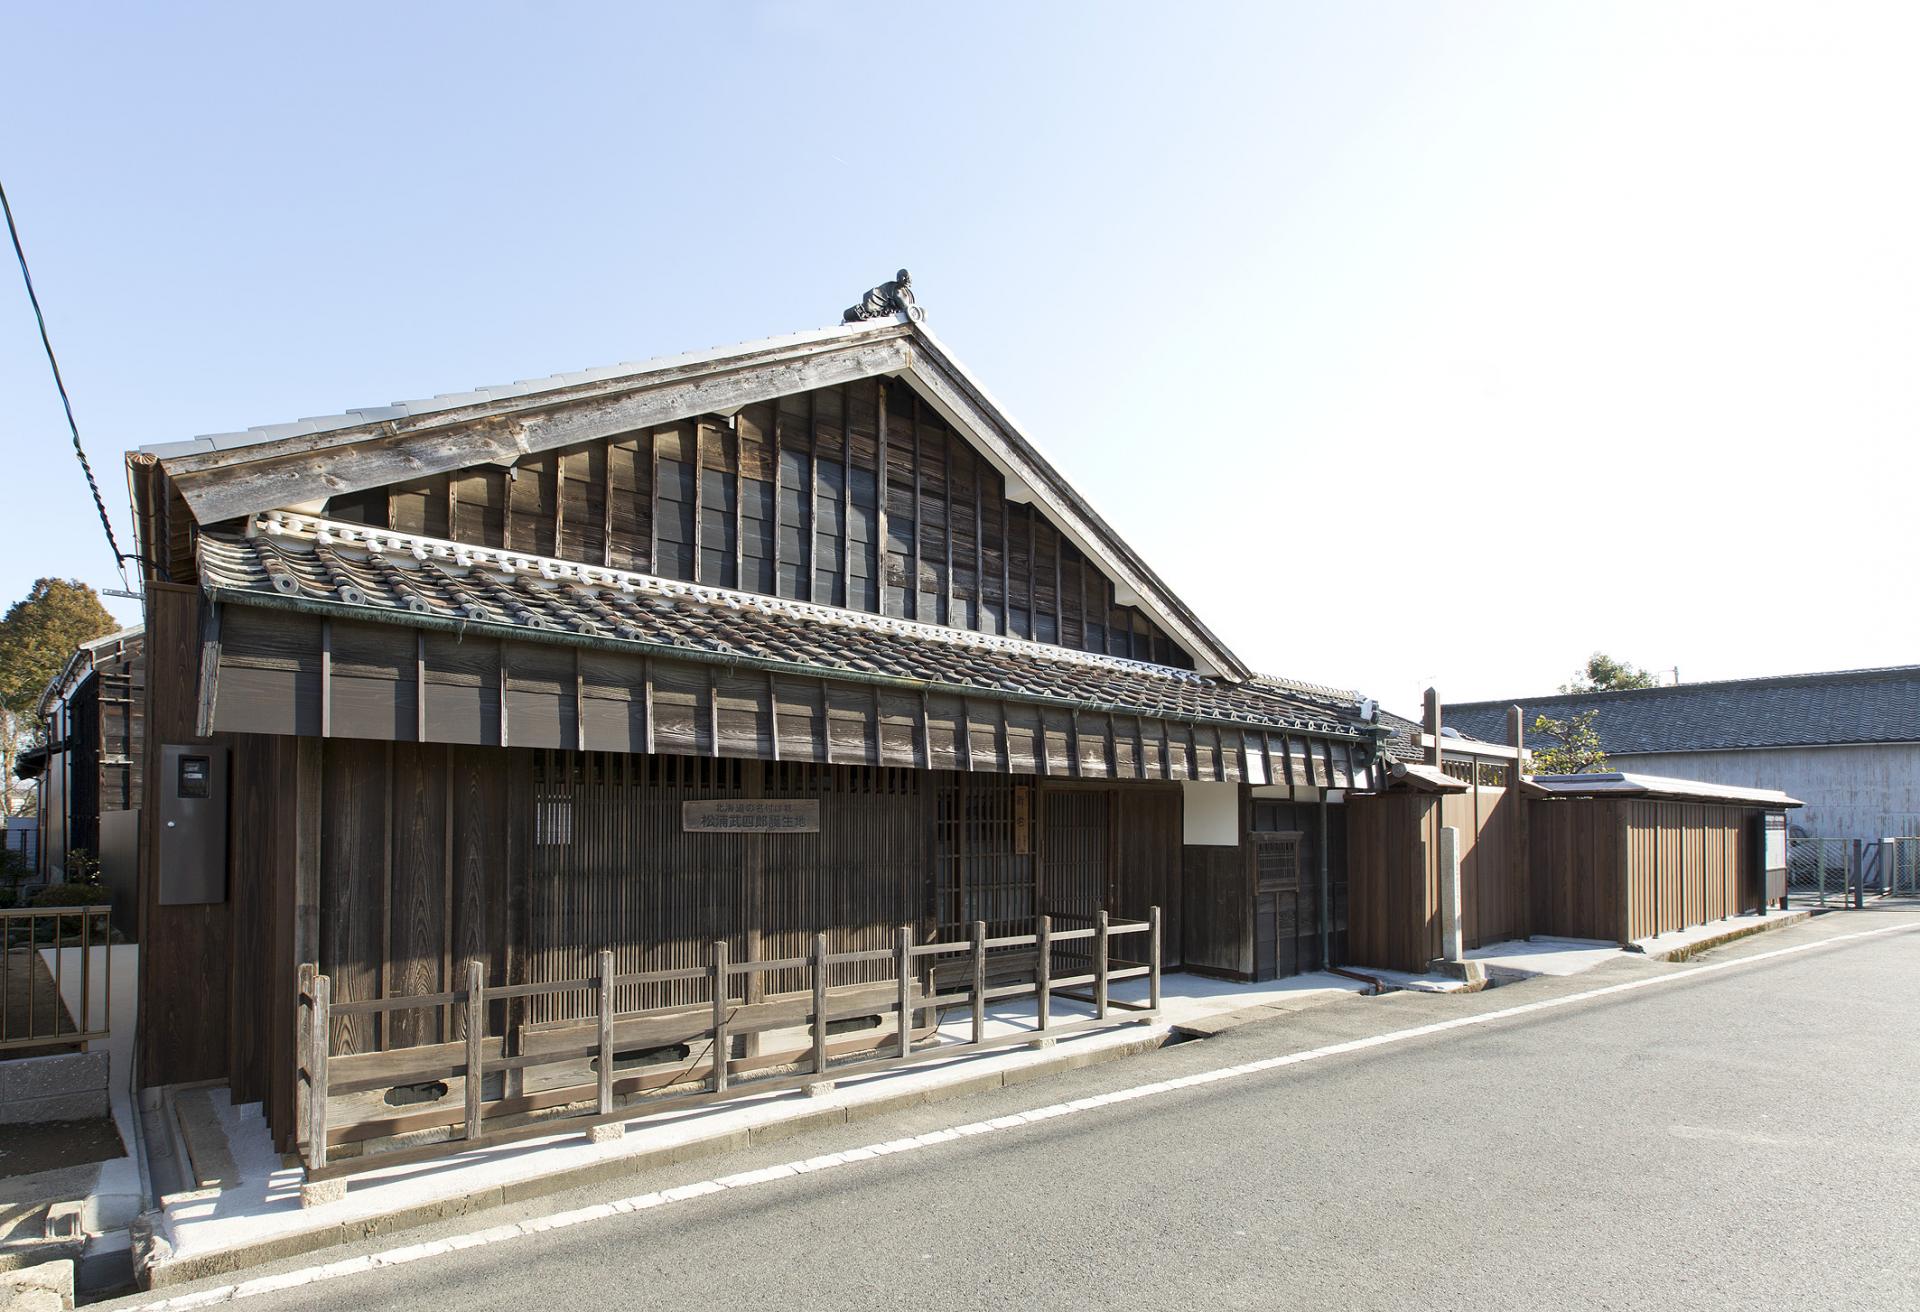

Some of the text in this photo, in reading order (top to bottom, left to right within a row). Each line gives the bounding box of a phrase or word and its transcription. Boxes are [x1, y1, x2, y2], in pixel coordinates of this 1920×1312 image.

[700, 814, 807, 828] 松浦武四郎誕生地
